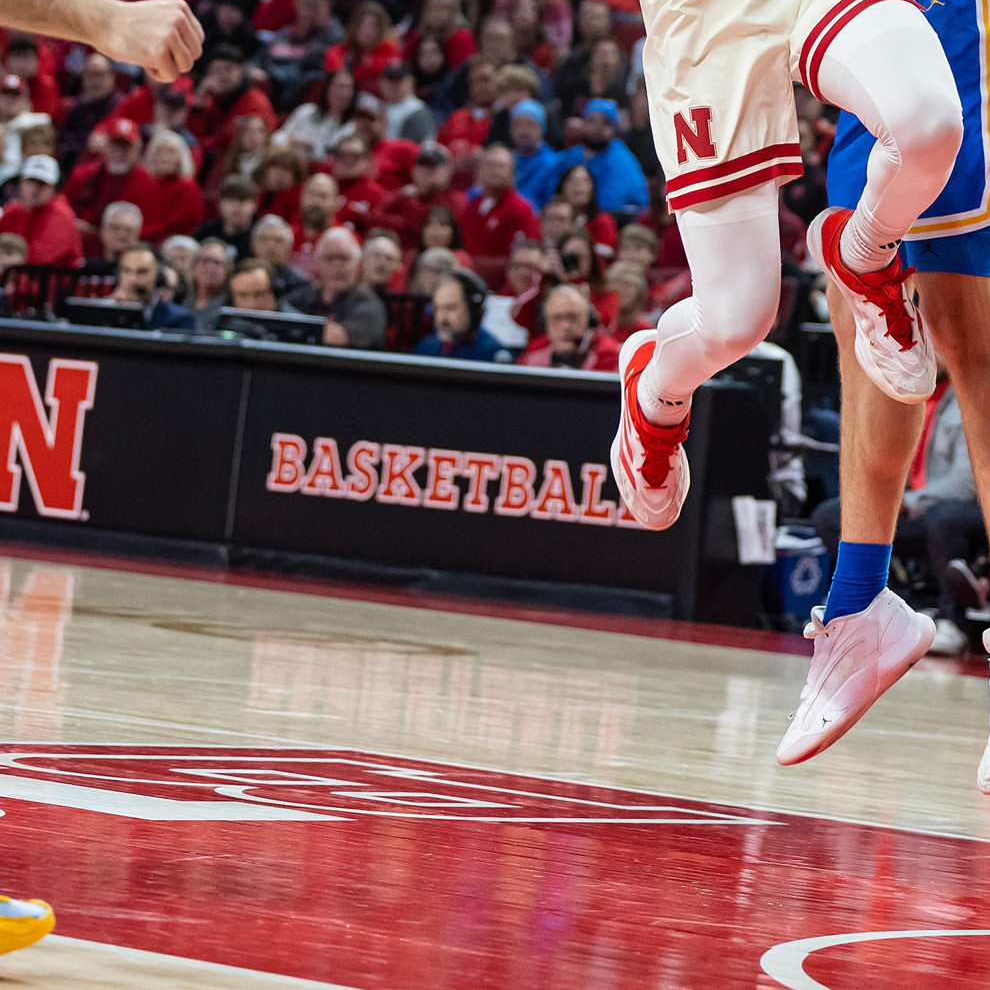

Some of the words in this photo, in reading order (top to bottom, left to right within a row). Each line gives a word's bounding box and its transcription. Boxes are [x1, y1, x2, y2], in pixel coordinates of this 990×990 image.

[673, 106, 718, 166] N
[0, 353, 98, 520] N
[266, 433, 649, 530] BASKETBAL
